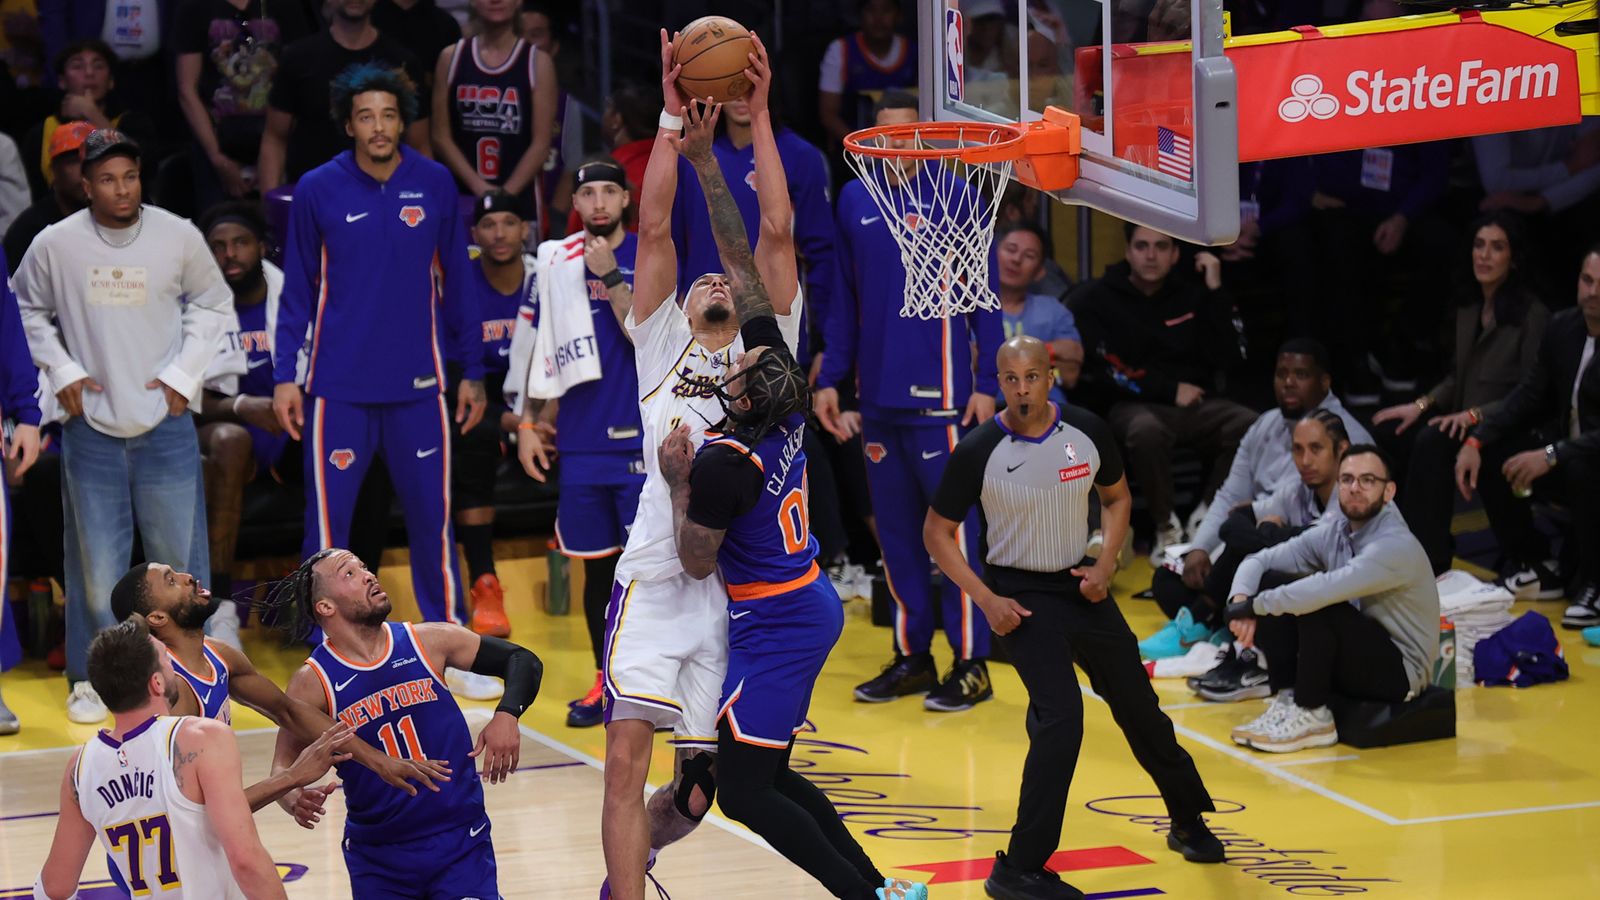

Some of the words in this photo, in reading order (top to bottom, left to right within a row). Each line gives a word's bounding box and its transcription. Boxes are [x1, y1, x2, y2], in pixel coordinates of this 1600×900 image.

[456, 85, 519, 119] USA
[476, 136, 500, 179] 6
[1060, 467, 1089, 480] Emirates
[381, 677, 438, 711] YORK
[377, 714, 427, 760] 11
[96, 766, 155, 809] DONČIĆ
[103, 812, 182, 897] 77
